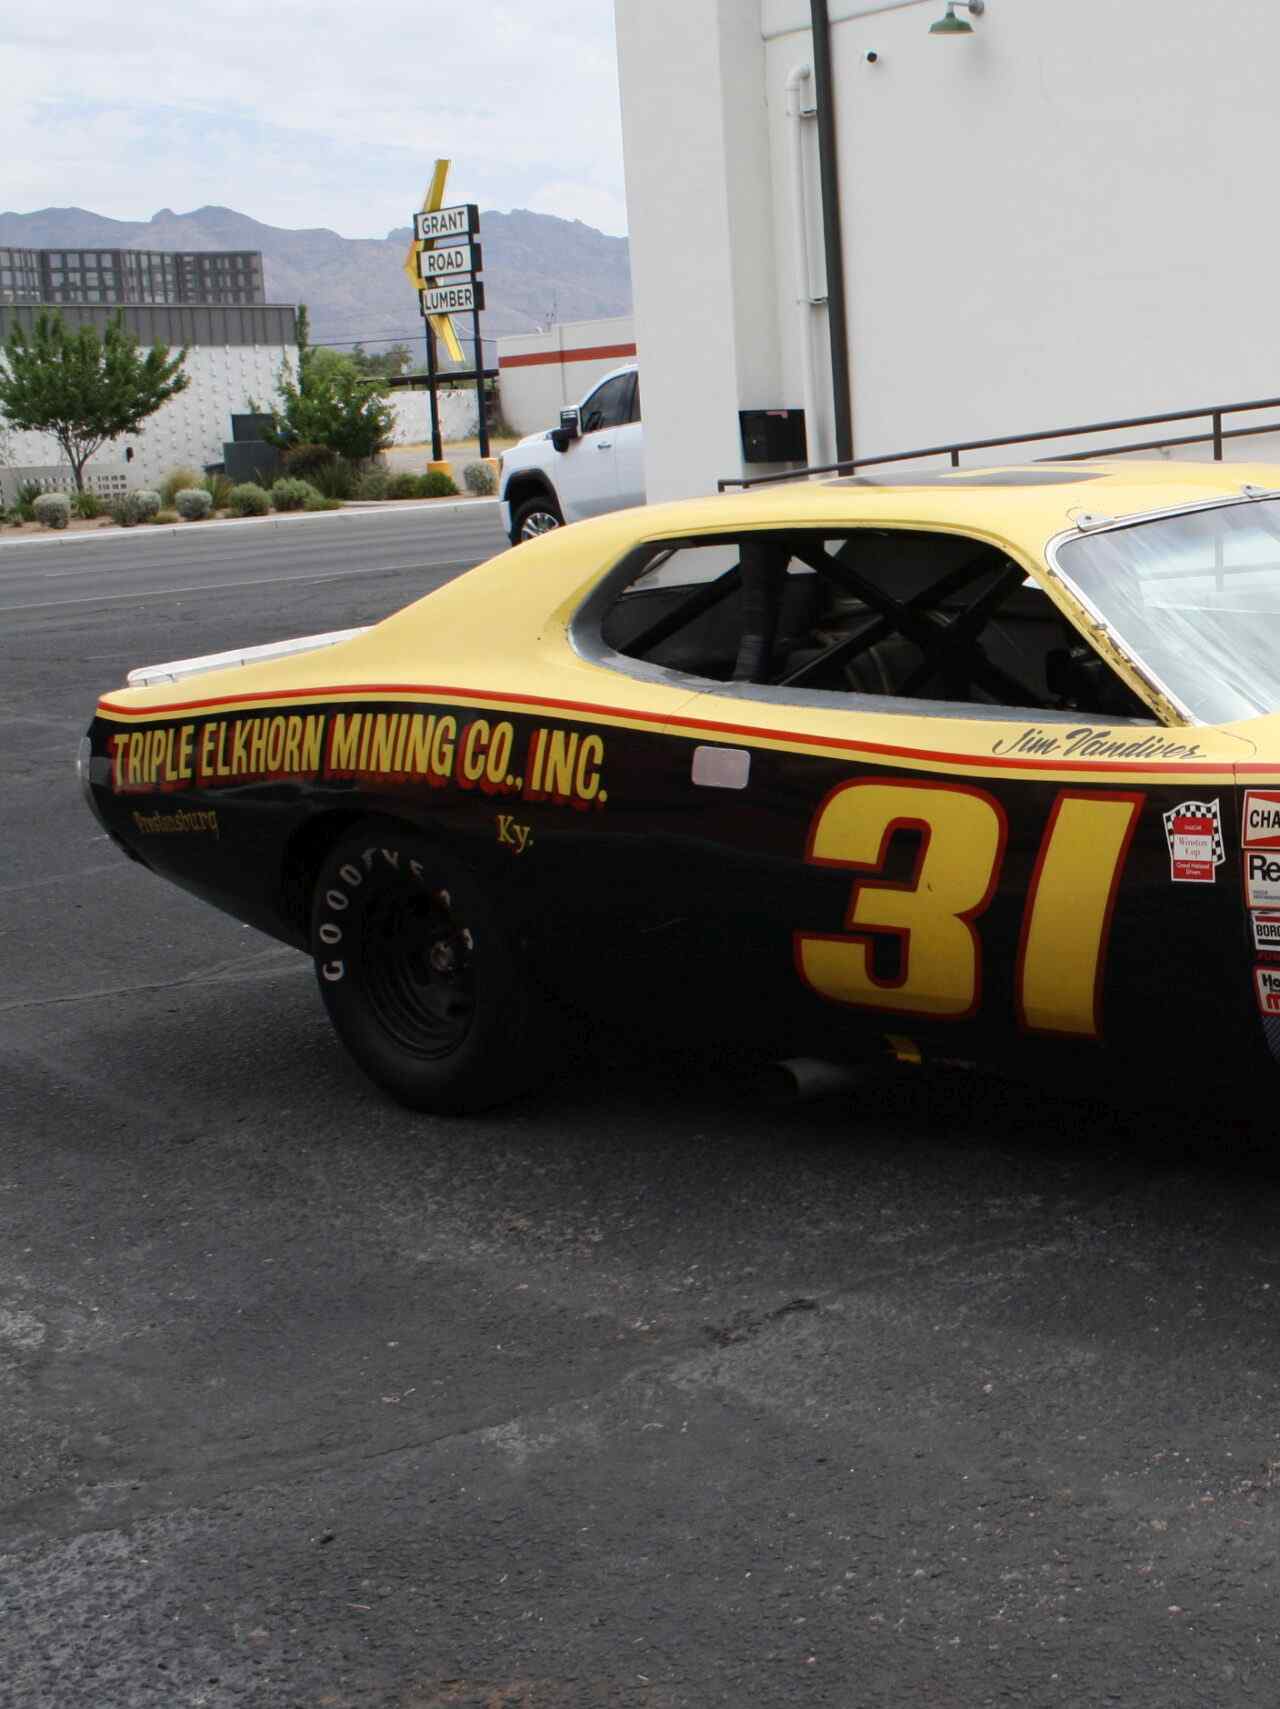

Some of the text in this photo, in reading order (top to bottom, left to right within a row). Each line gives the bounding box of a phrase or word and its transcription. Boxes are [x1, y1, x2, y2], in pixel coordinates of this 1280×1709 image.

[422, 211, 465, 234] GRANT
[428, 251, 464, 272] ROAD
[425, 289, 473, 310] LUMBER
[992, 728, 1061, 755] Jim
[110, 725, 195, 787] TRIPLE
[200, 715, 325, 777] ELKHORN
[330, 713, 457, 777] MINING
[530, 728, 608, 803] INC.
[497, 814, 534, 853] Ky.
[792, 776, 1147, 1040] 31
